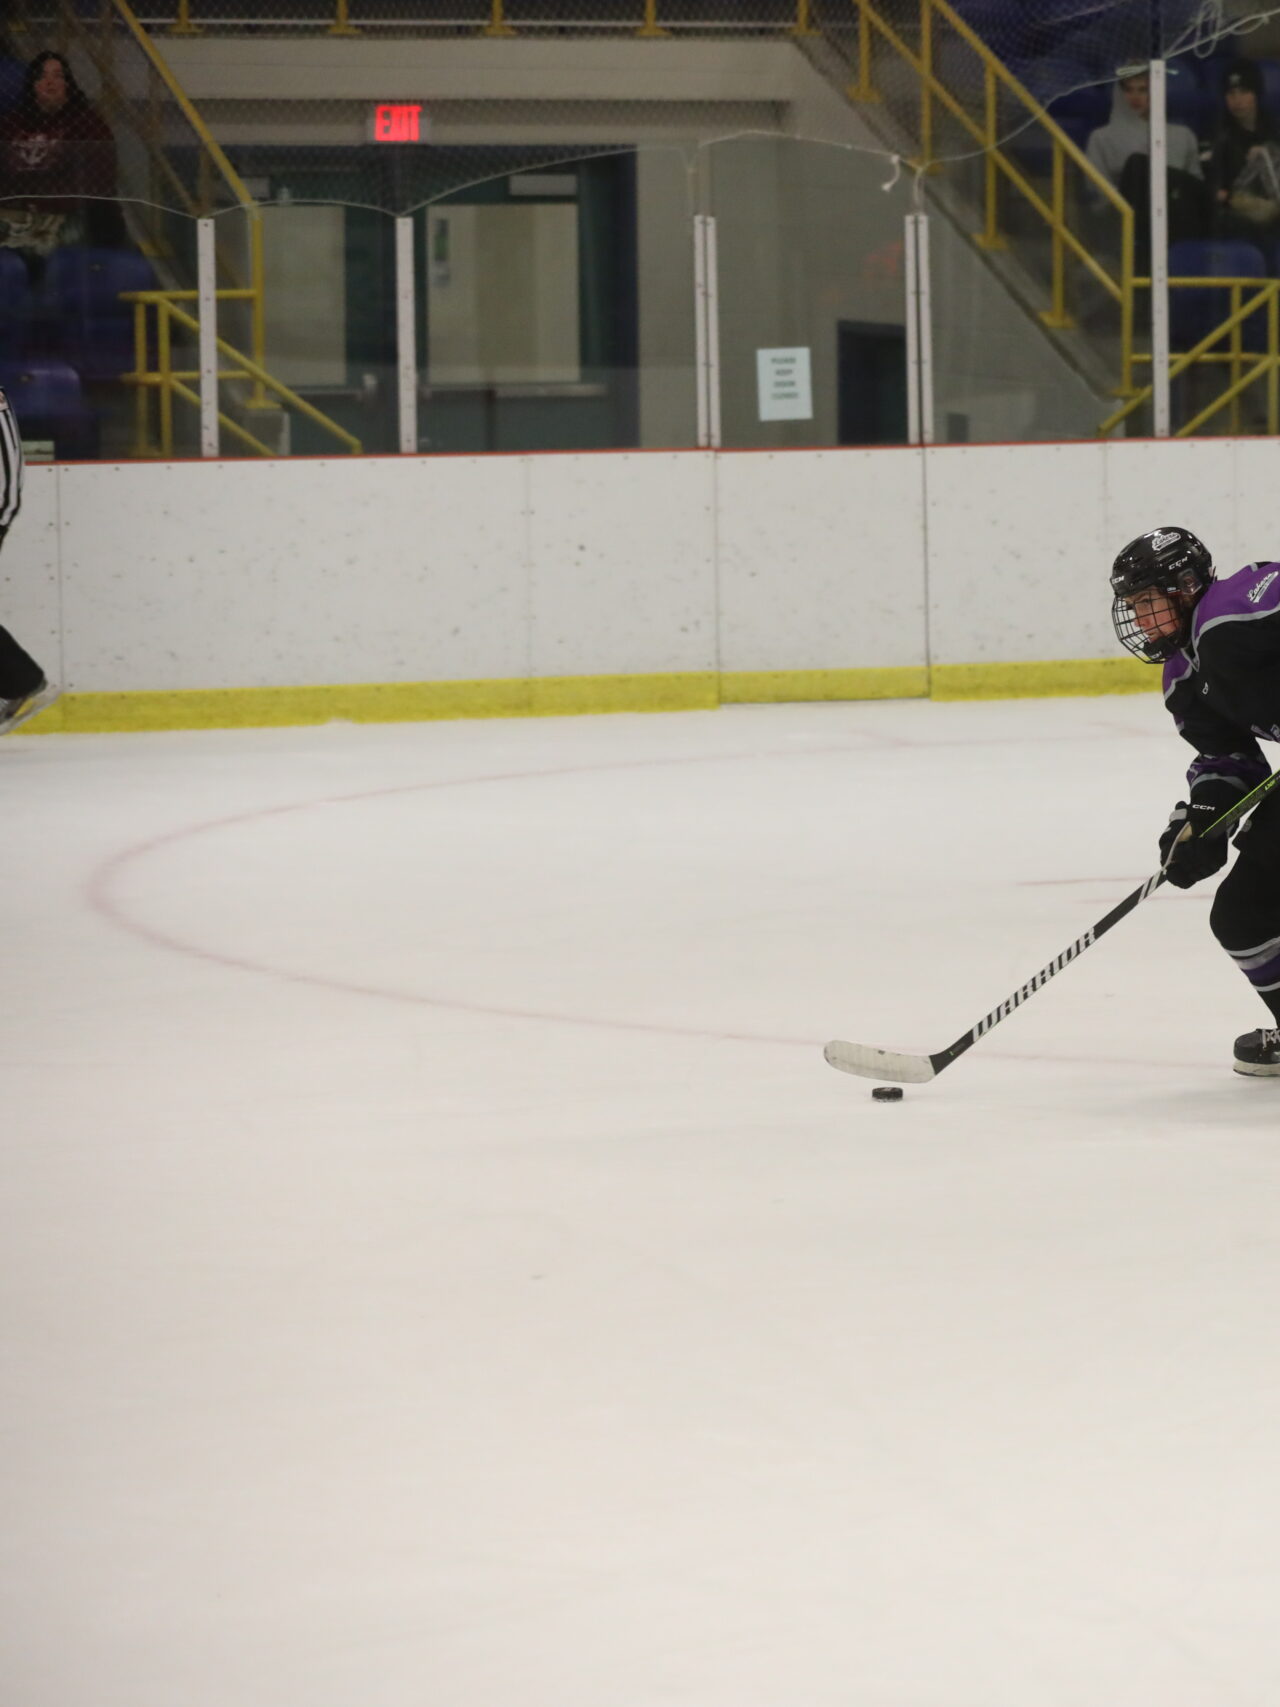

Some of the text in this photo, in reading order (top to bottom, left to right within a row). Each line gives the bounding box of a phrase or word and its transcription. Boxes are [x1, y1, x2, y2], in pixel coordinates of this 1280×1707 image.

[375, 105, 423, 142] EXIT
[1168, 556, 1188, 570] CCM
[972, 926, 1097, 1043] WARRIOR
